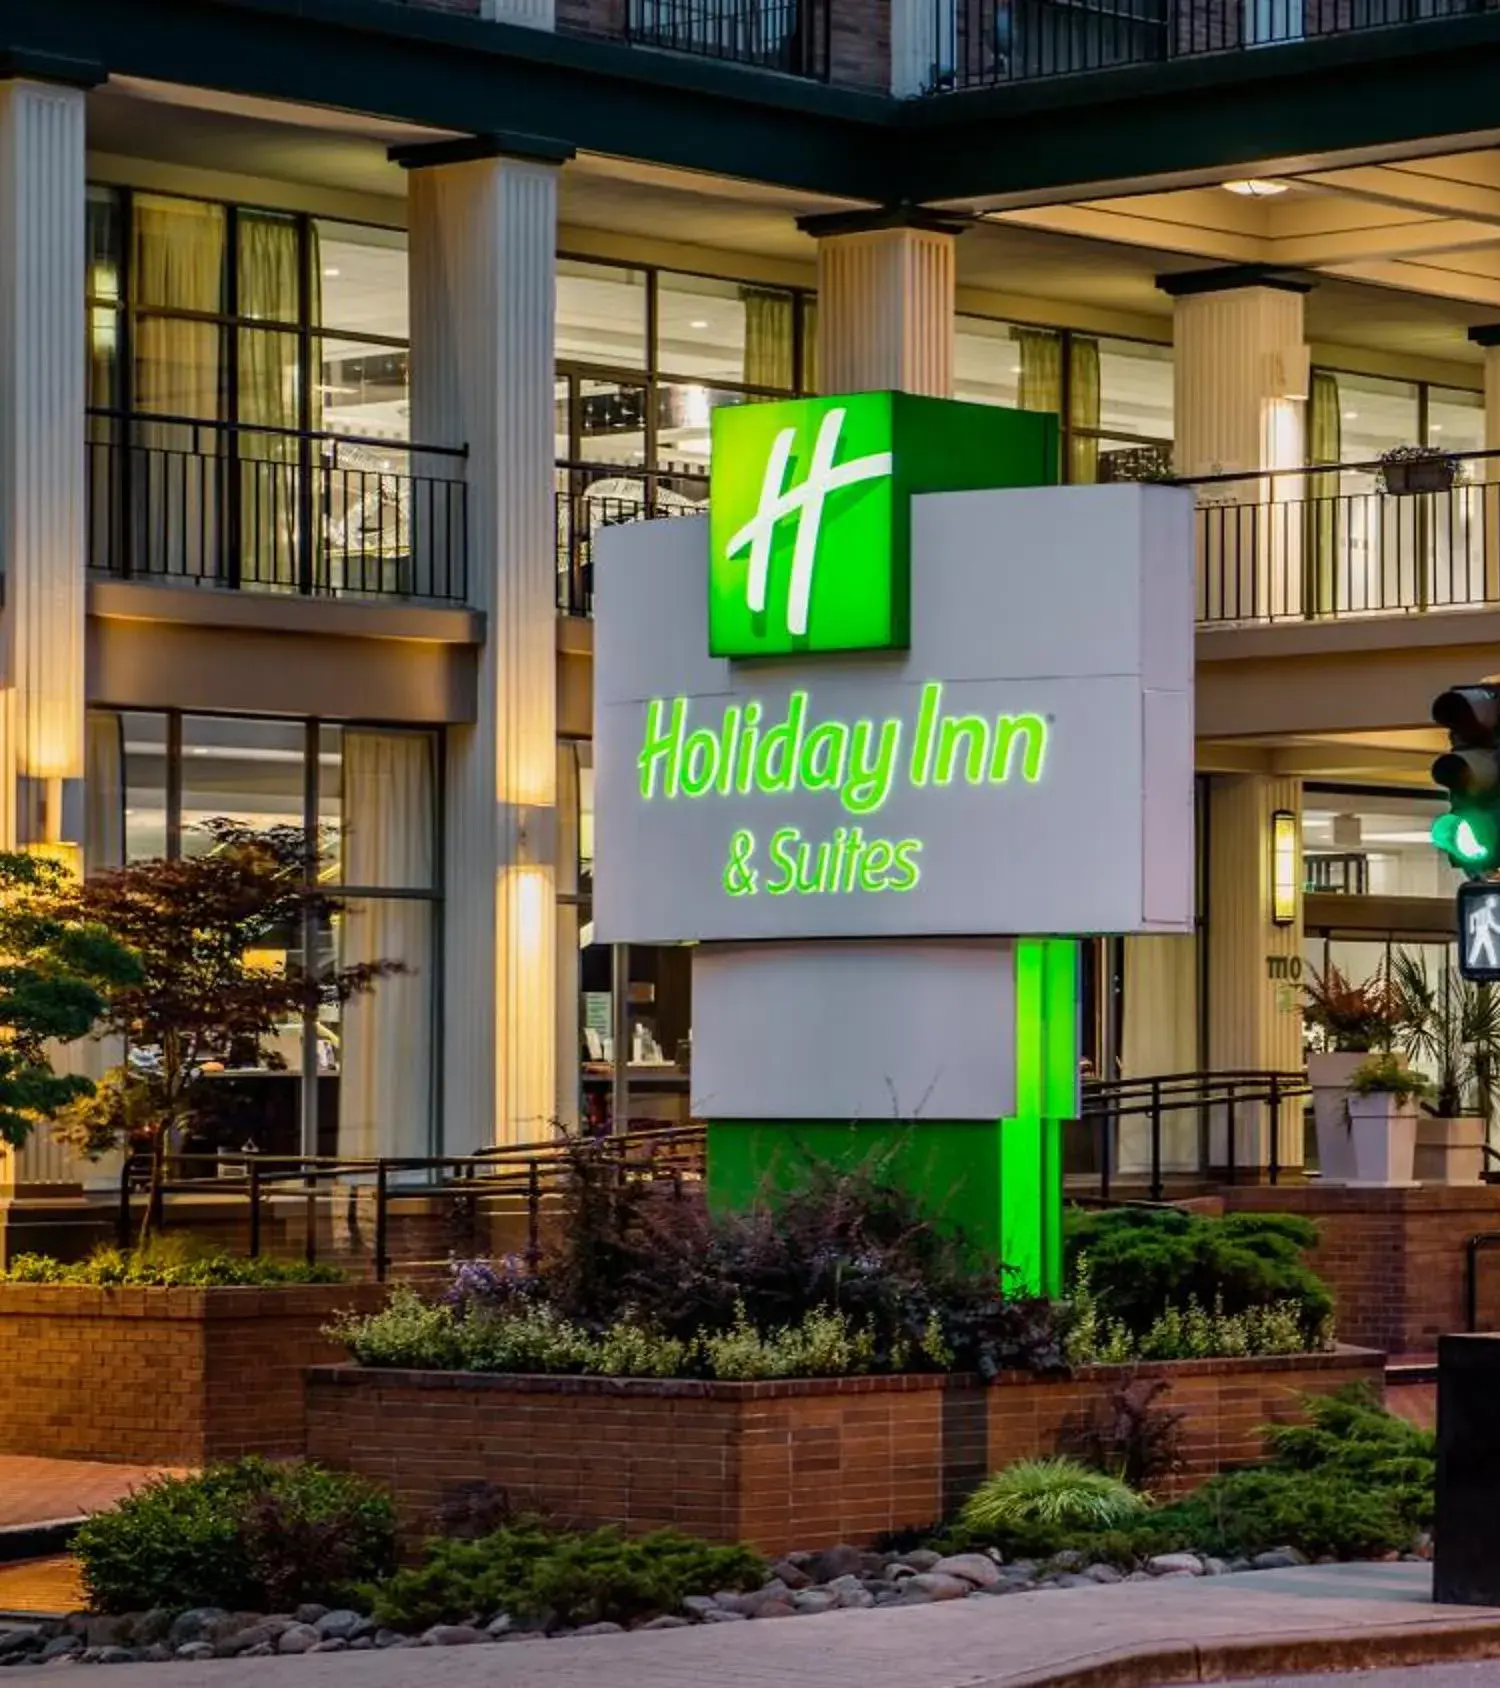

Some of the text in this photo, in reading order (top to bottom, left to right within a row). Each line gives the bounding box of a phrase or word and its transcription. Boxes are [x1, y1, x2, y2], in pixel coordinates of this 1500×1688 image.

[727, 408, 892, 635] H
[637, 682, 1049, 814] Holiday Inn
[722, 826, 924, 896] & Suites
